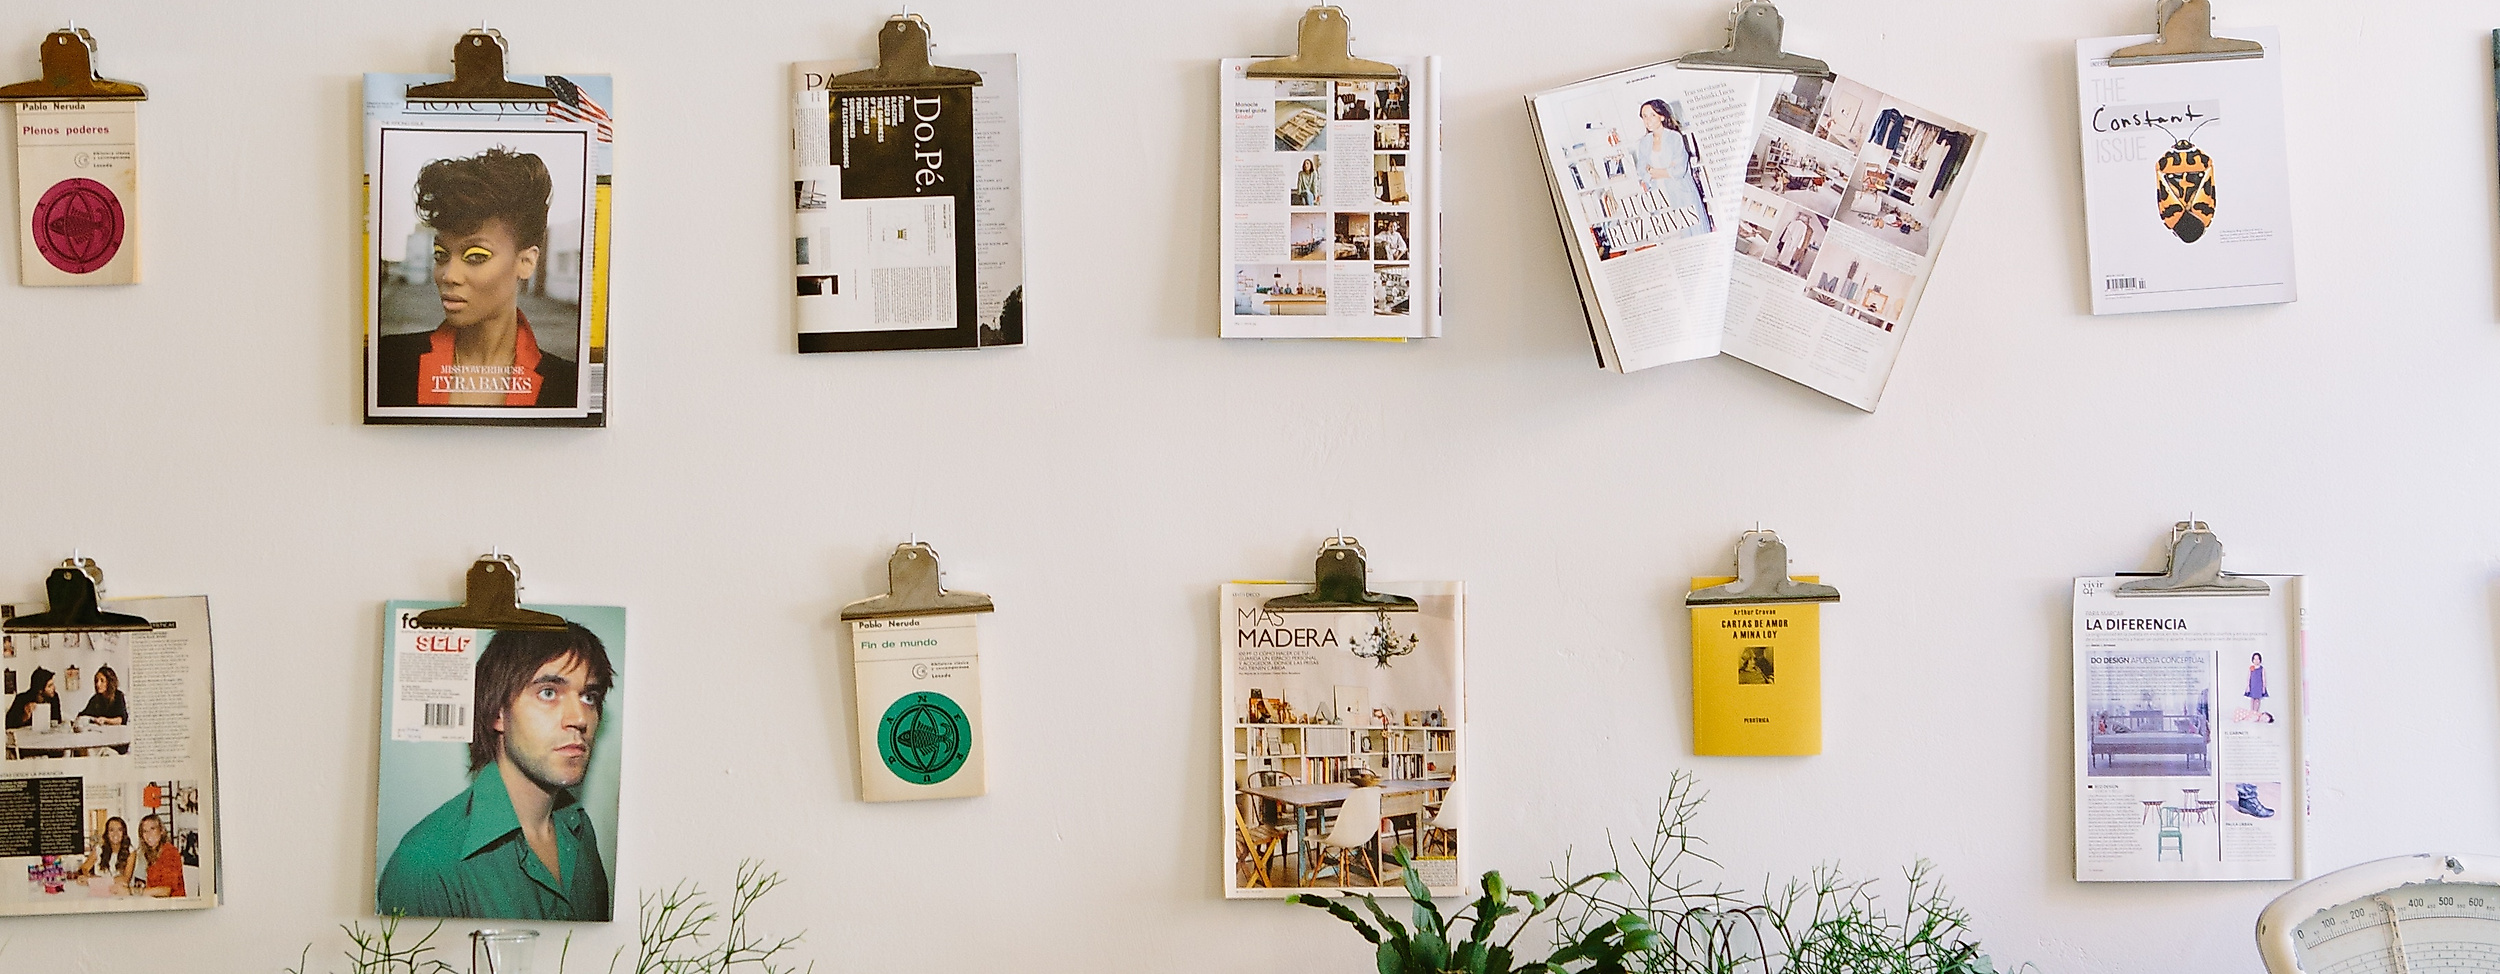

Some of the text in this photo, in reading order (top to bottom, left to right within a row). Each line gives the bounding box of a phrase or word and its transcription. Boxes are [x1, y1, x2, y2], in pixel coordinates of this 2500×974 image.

[2091, 78, 2126, 103] THE
[22, 102, 86, 111] Pablo Neruda
[2092, 104, 2204, 133] Constant
[23, 125, 110, 136] Plenos poderes
[913, 94, 945, 194] Do.Pé.
[2096, 136, 2148, 163] ISSUE
[1607, 206, 1700, 249] RUIZ-RIVAS
[432, 376, 532, 391] TYRA BANKS
[402, 613, 453, 629] fo
[859, 619, 920, 629] Pablo Neruda
[1721, 619, 1788, 628] CARTAS DE AMOR
[2086, 618, 2188, 630] LA DIFERENCIA
[1238, 628, 1339, 648] MADERA
[1732, 630, 1777, 639] A MINA LOY
[416, 635, 471, 652] SELF
[861, 638, 938, 649] Fin de mundo
[2408, 896, 2484, 907] 400 500 600
[2297, 908, 2365, 940] 0 100 200
